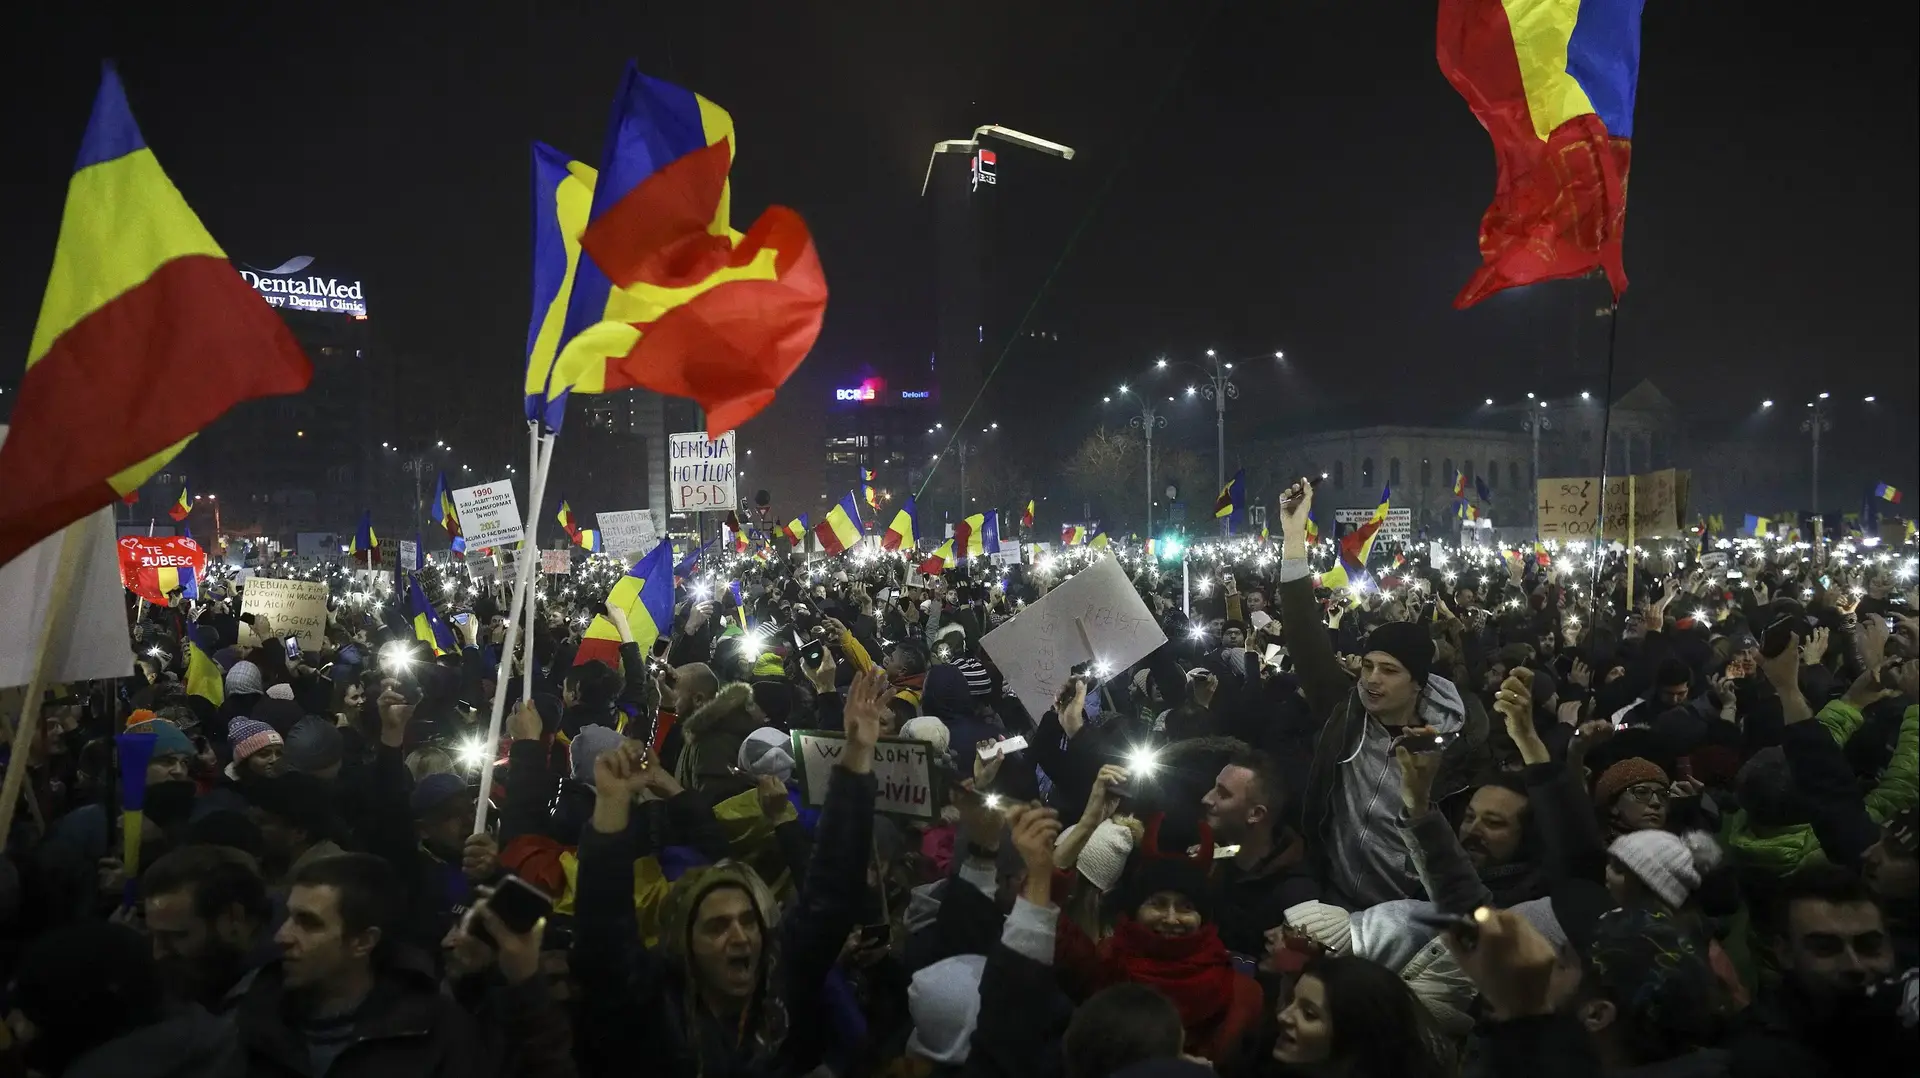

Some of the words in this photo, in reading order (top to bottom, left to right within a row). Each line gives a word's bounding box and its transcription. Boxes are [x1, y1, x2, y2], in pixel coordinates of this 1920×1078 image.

[240, 270, 363, 299] DentalMed
[289, 295, 328, 308] Dental
[330, 299, 364, 312] Clinic
[473, 487, 492, 497] 1990
[479, 519, 501, 532] 2017
[465, 534, 481, 542] ACUM
[143, 546, 163, 555] TE
[244, 589, 257, 597] CU
[244, 599, 260, 608] NU
